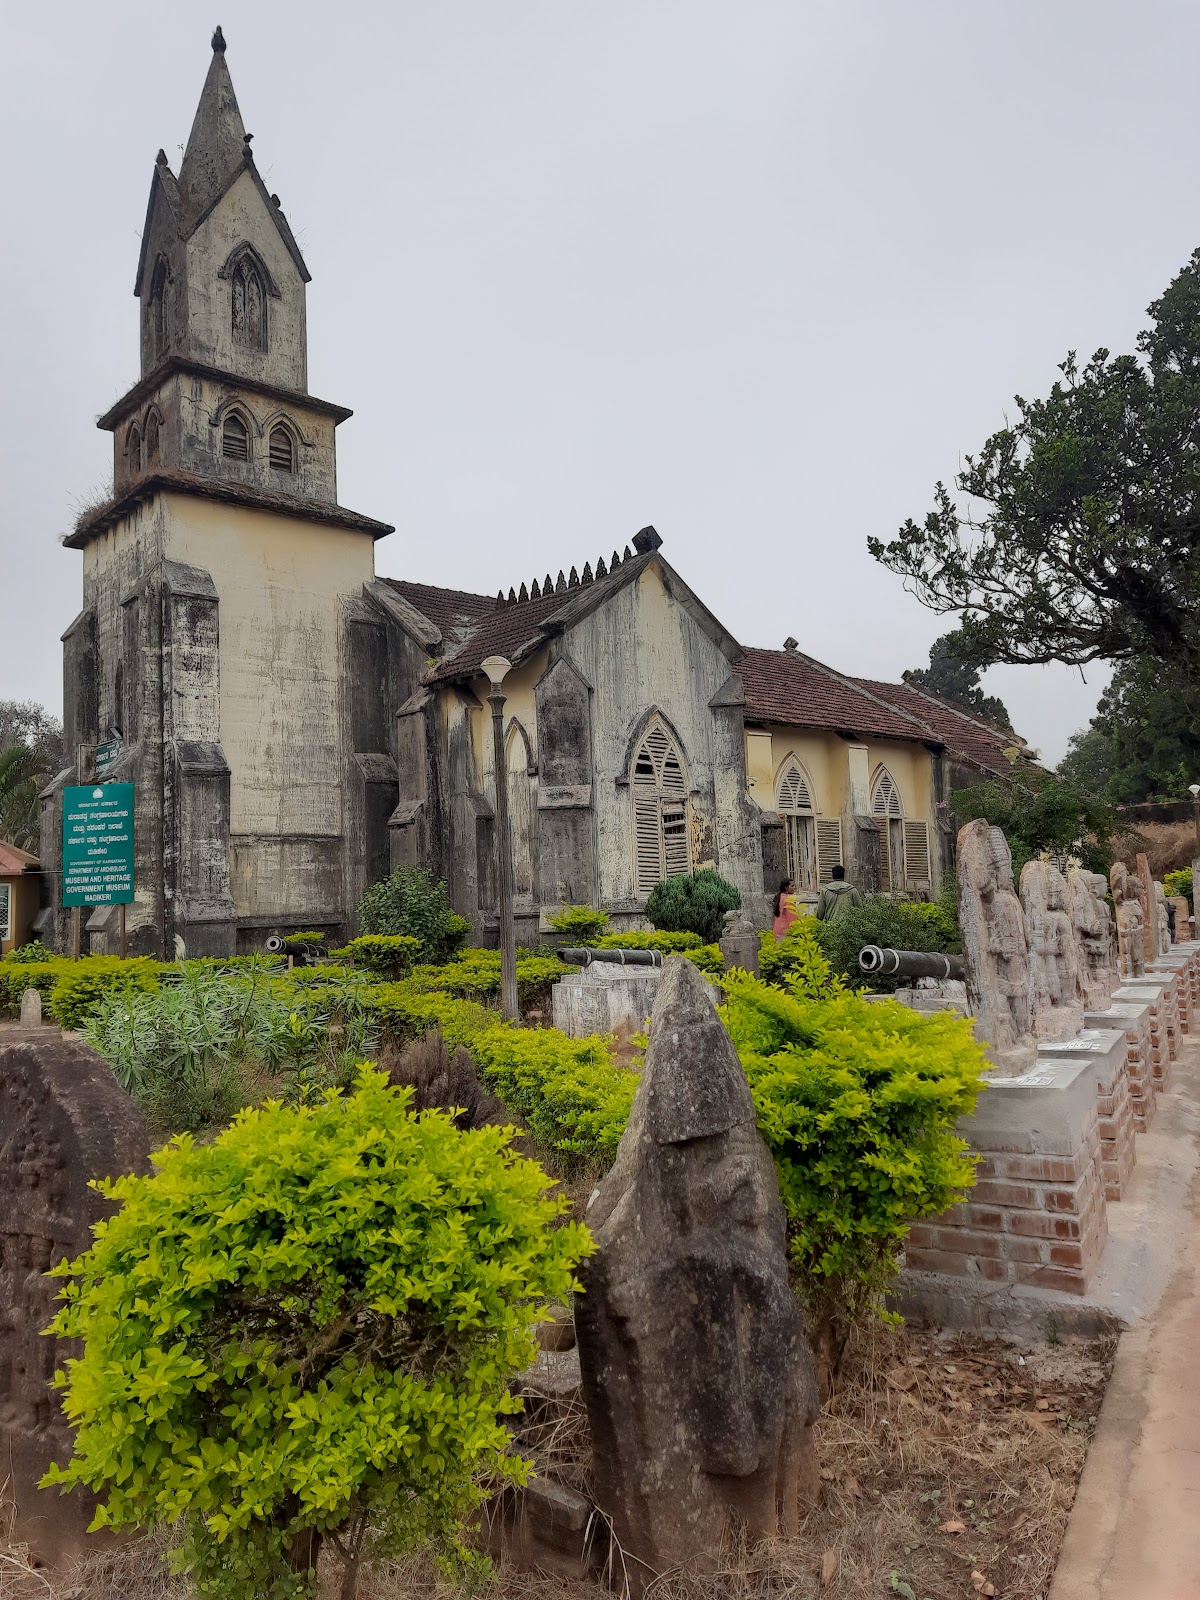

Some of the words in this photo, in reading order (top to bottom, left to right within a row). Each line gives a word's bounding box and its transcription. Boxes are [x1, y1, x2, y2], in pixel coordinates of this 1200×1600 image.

[68, 867, 93, 875] DEPARTMENT
[65, 876, 89, 884] MUSEUM
[89, 875, 102, 883] AND
[103, 873, 131, 882] HERITAGE
[66, 884, 105, 893] GOVERNMENT
[105, 883, 130, 891] MUSEUM
[84, 893, 112, 902] MADIKERI
